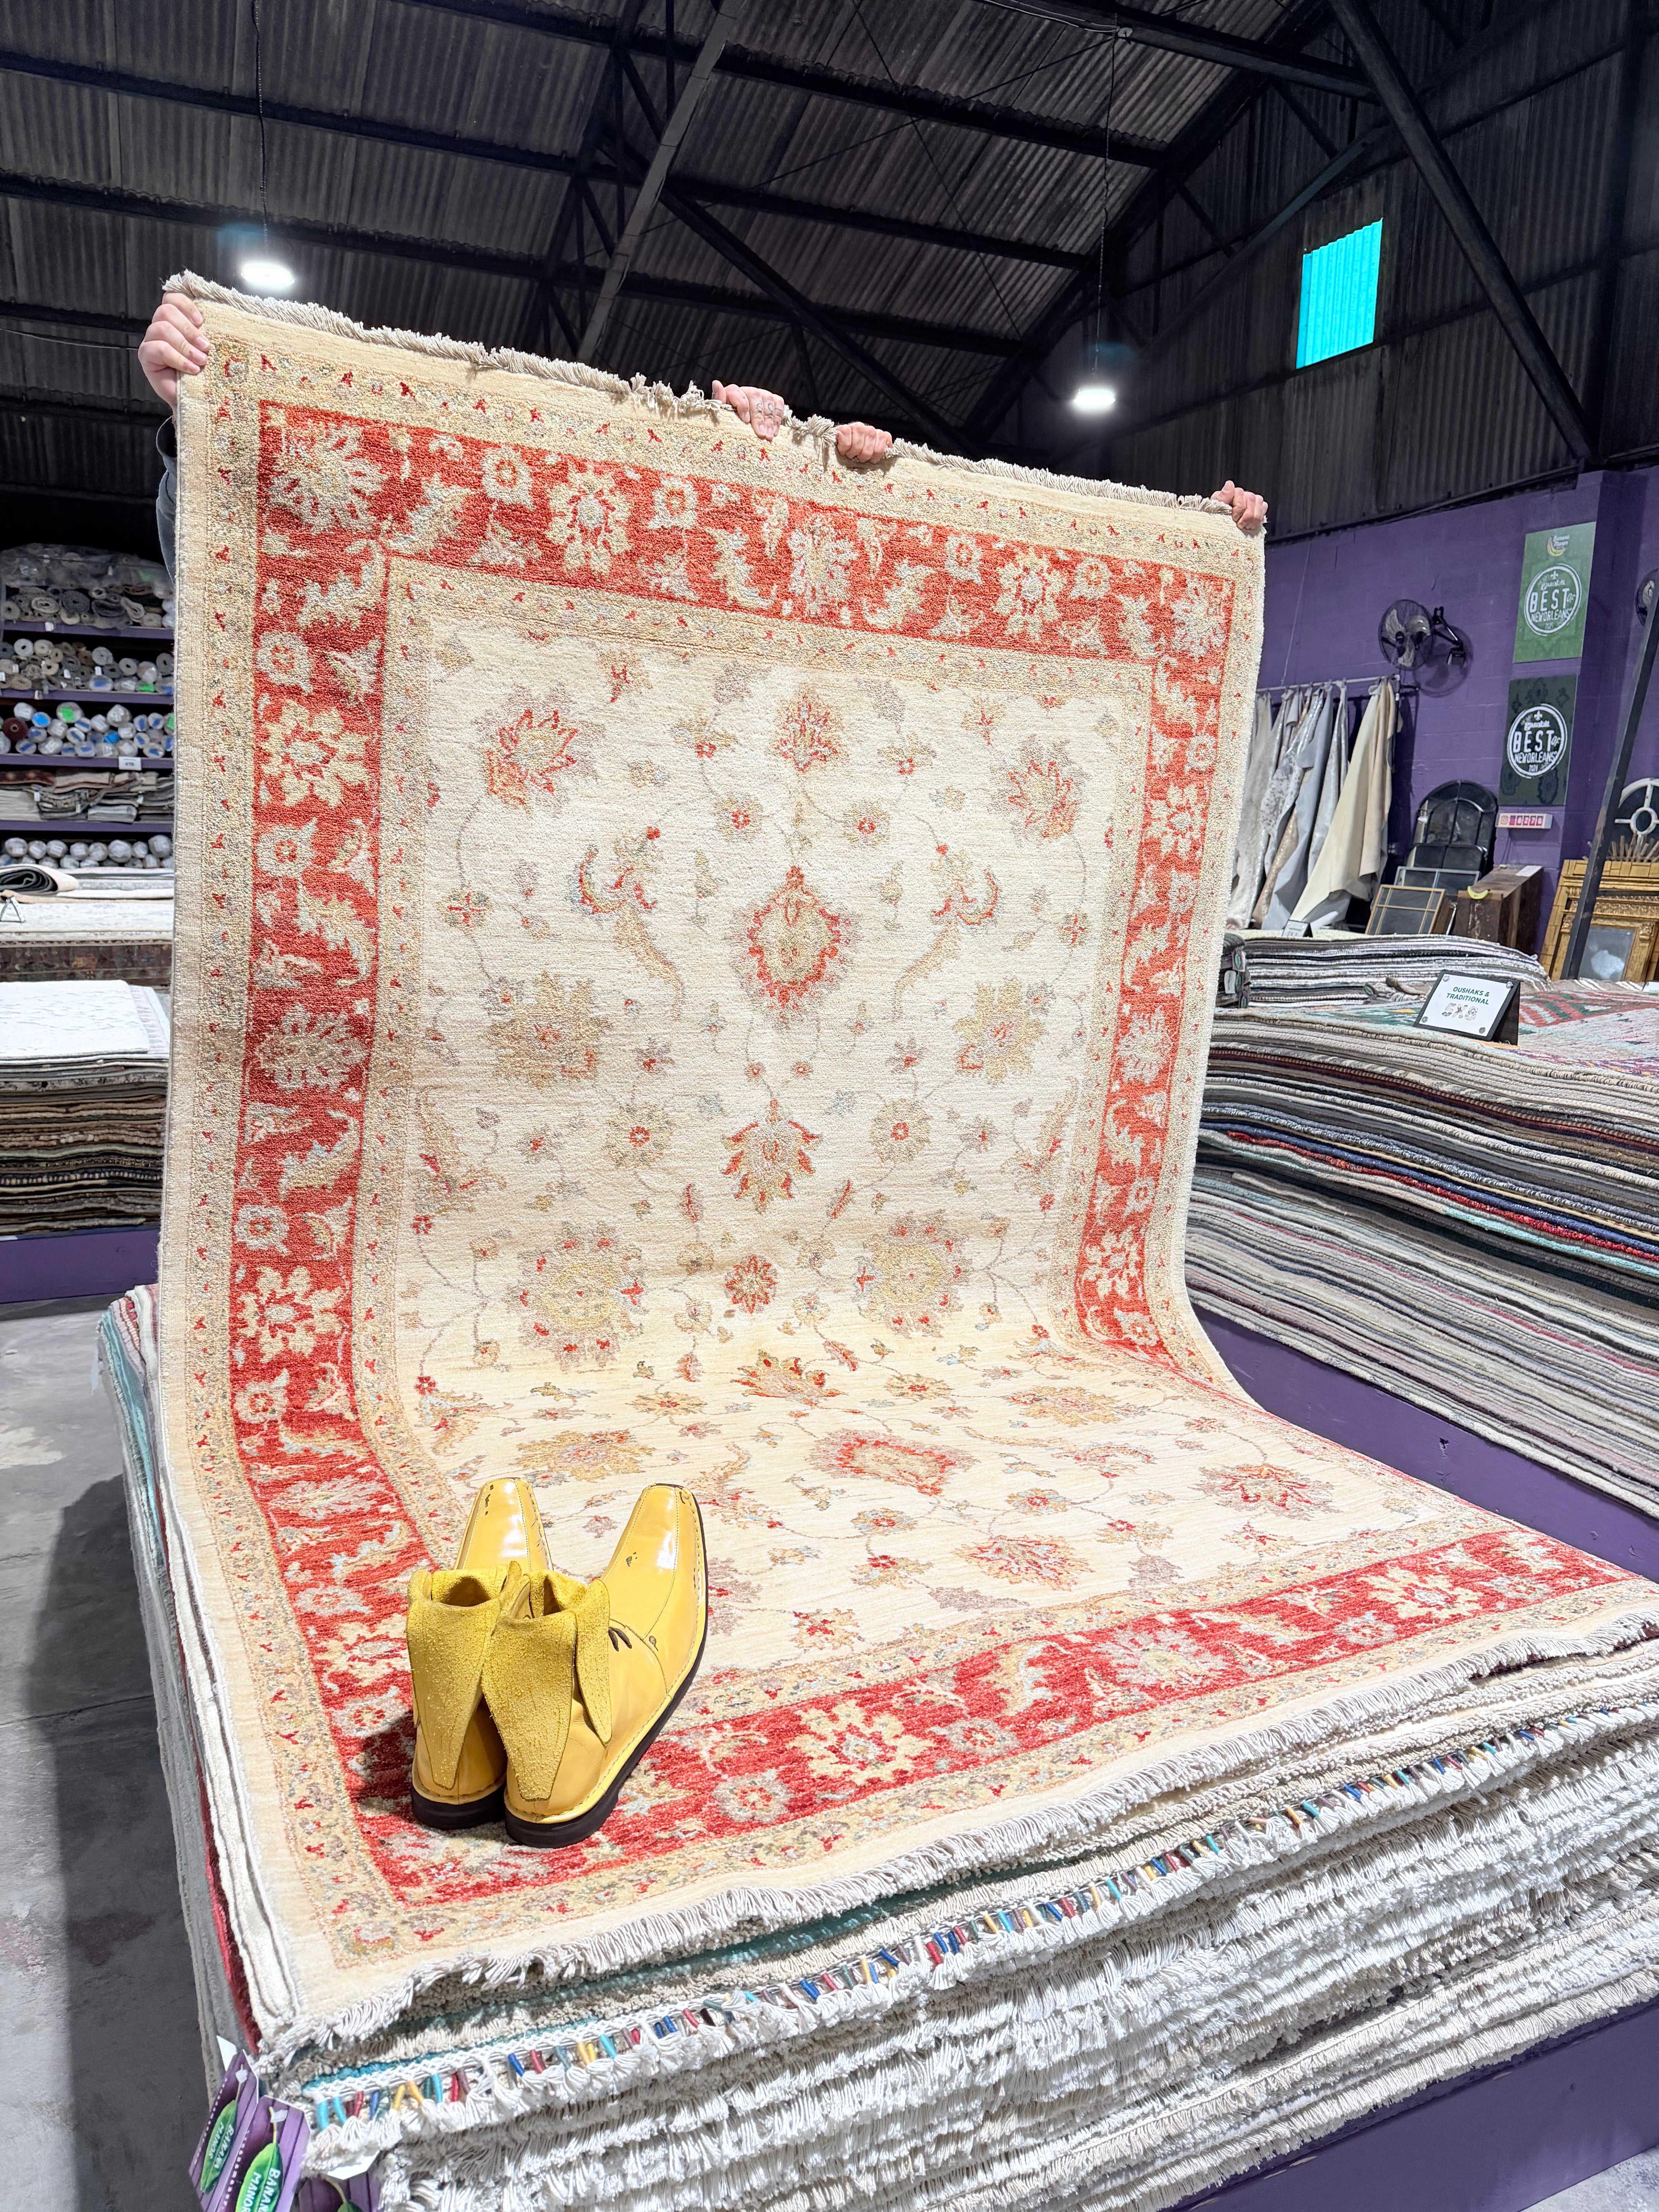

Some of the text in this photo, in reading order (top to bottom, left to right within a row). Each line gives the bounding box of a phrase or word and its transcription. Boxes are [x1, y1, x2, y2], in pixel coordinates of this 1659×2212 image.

[1530, 588, 1570, 613] BEST
[1513, 730, 1561, 753] BEST OF
[1446, 993, 1489, 1005] TRADITIONAL
[1453, 987, 1484, 996] OUSHAKS
